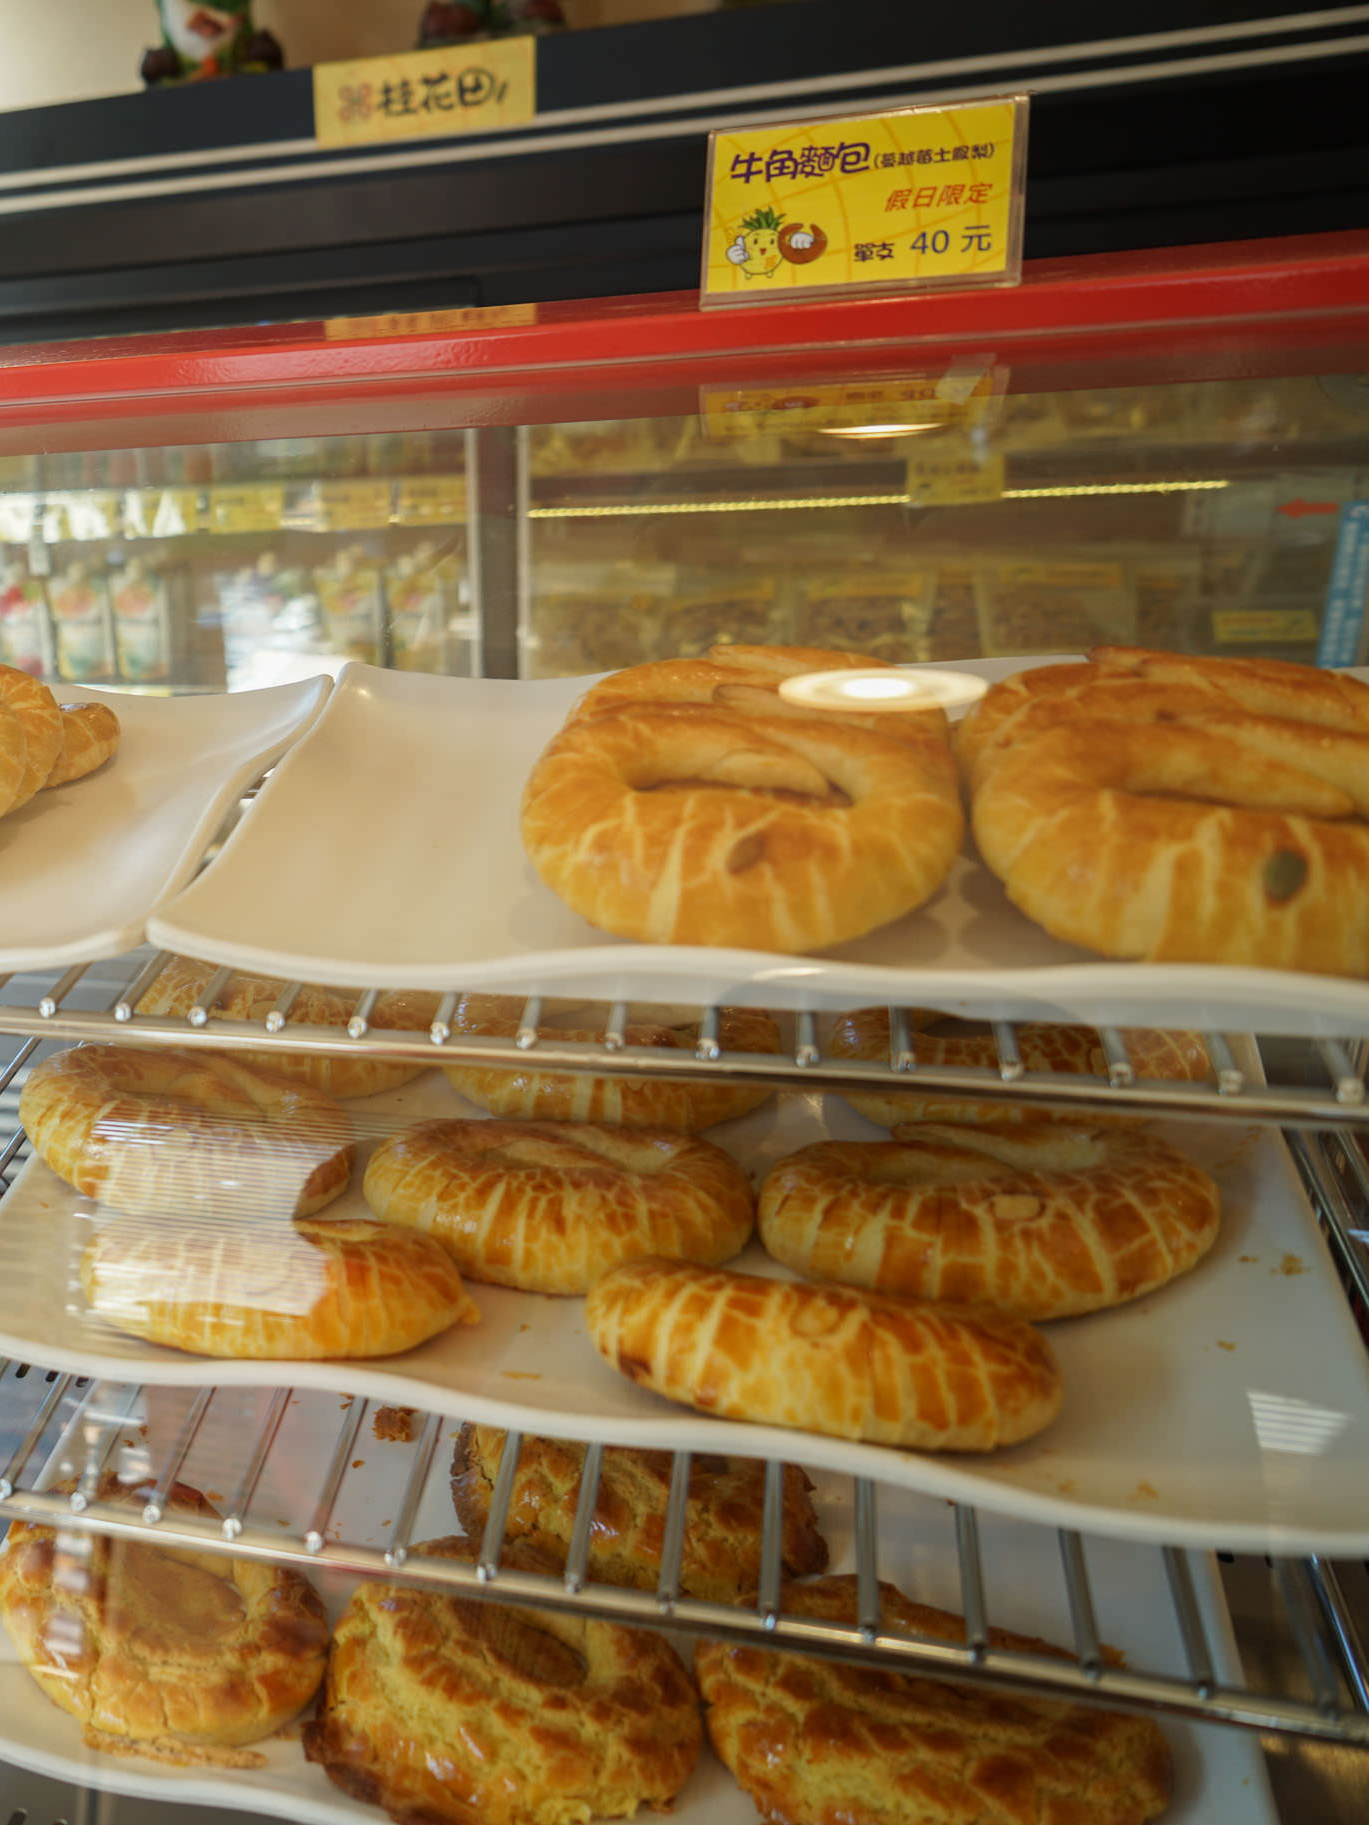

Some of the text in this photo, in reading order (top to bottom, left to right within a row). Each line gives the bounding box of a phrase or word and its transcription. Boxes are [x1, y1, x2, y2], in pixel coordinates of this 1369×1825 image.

[883, 182, 993, 213] 假日限定
[910, 229, 950, 254] 40
[961, 224, 992, 253] 元
